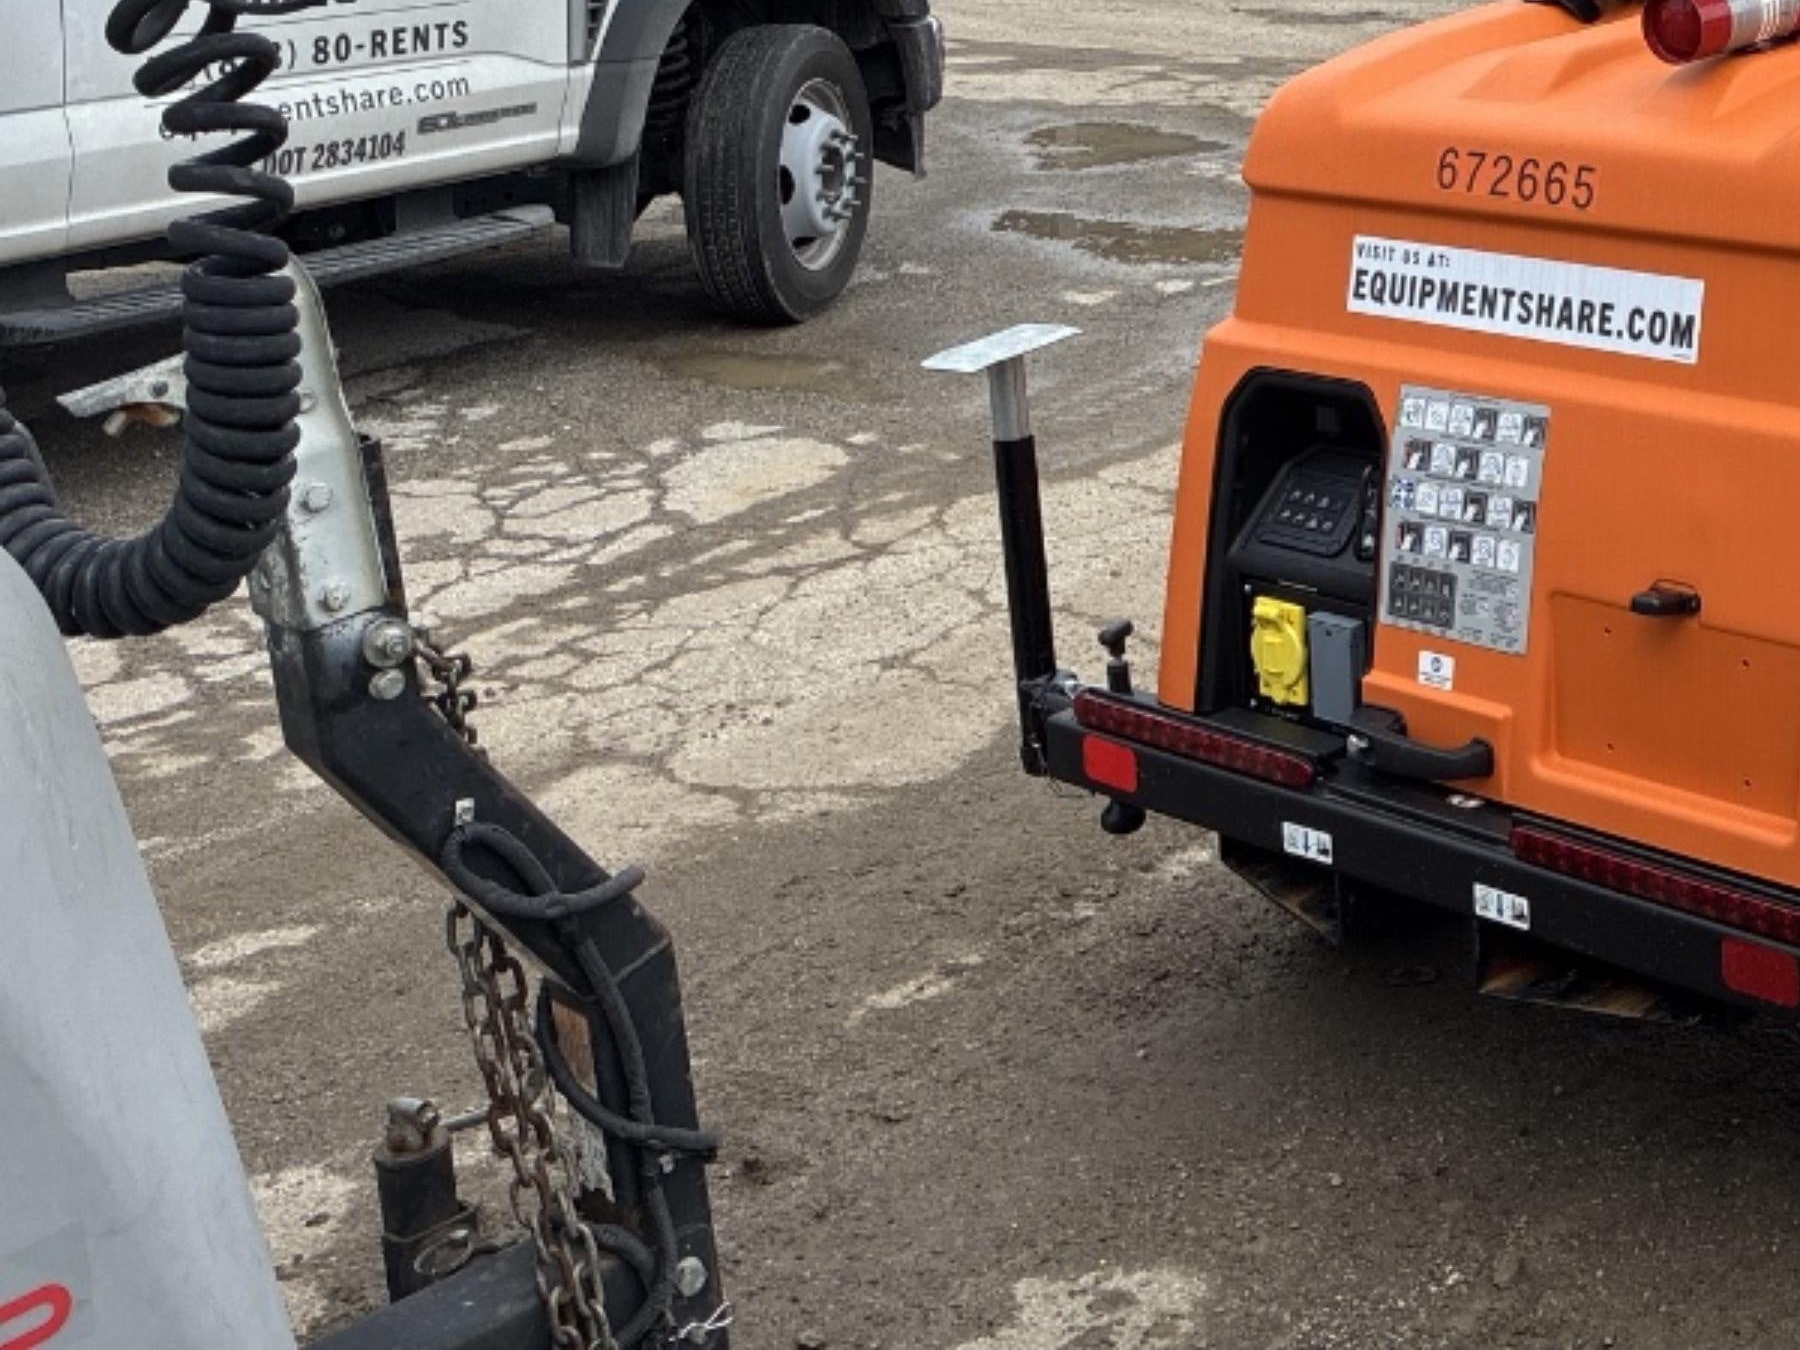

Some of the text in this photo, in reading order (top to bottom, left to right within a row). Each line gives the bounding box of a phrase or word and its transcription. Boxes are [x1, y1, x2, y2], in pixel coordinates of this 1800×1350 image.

[311, 20, 469, 66] 80-RENTS
[159, 75, 470, 142] entshare.com
[311, 130, 406, 171] 2834104
[1437, 147, 1596, 209] 672665
[1357, 242, 1396, 261] VISIT
[1353, 268, 1696, 350] EQUIPMENTSHARE.COM
